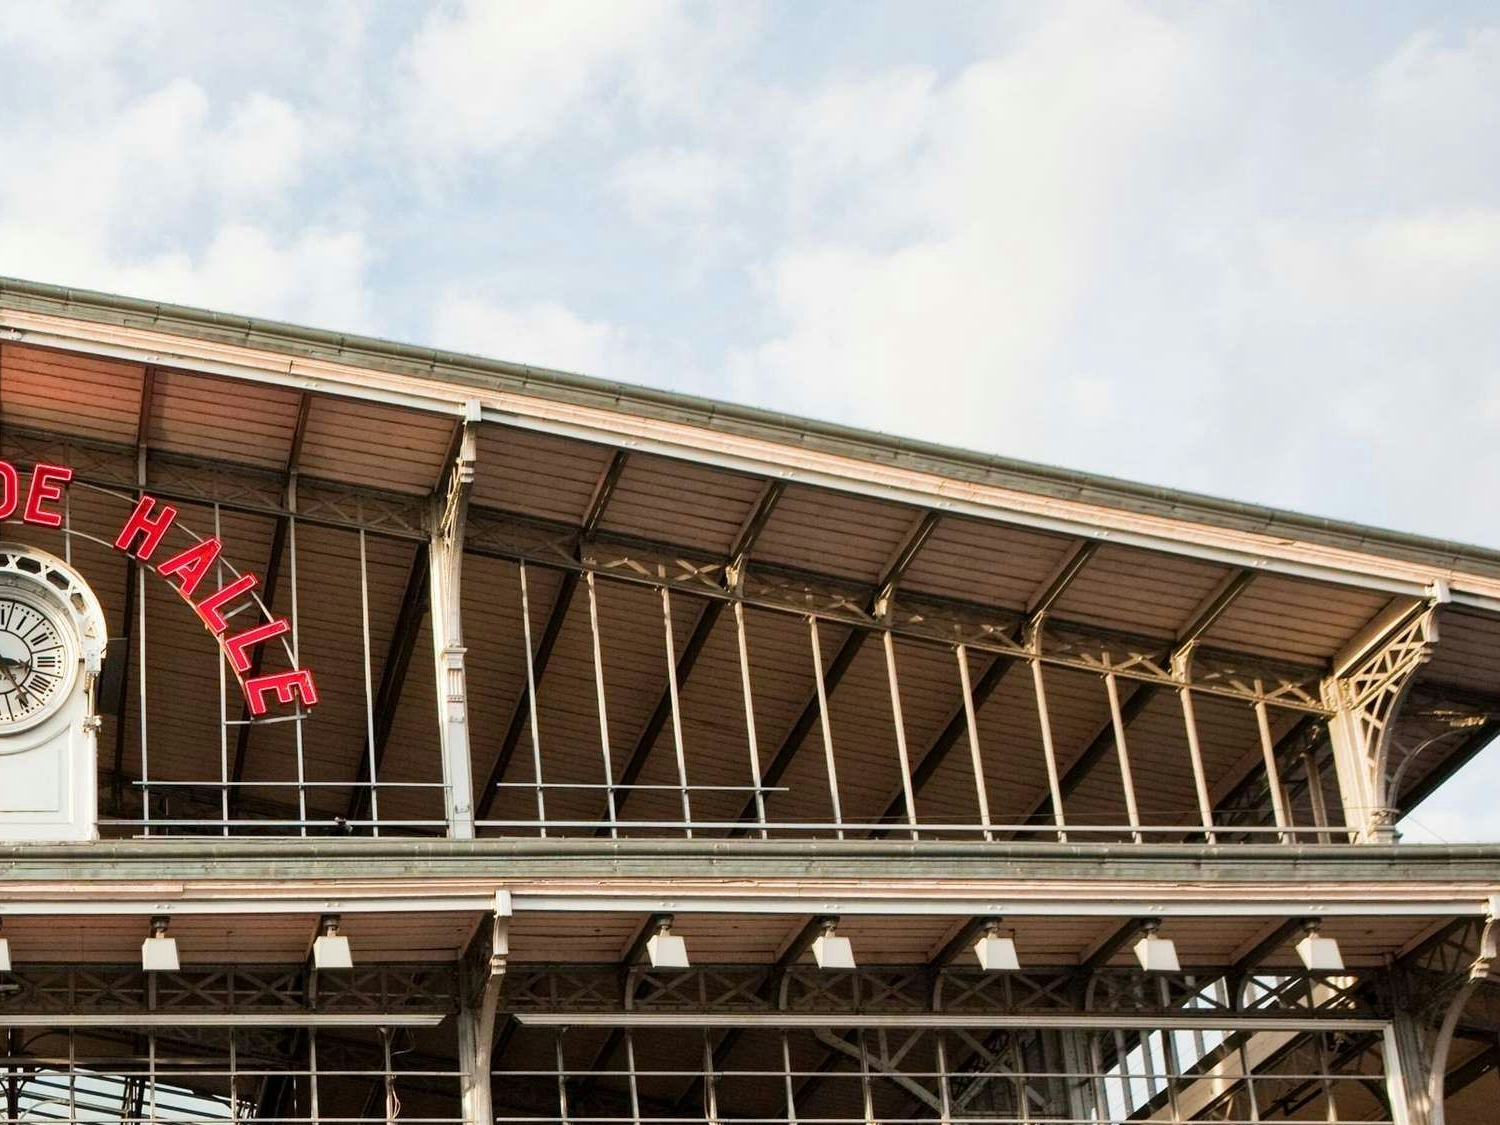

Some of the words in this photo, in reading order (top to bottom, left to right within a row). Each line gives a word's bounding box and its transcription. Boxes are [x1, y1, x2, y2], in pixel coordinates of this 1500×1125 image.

[114, 495, 320, 717] HALLE
[31, 633, 49, 646] II
[37, 656, 55, 667] III
